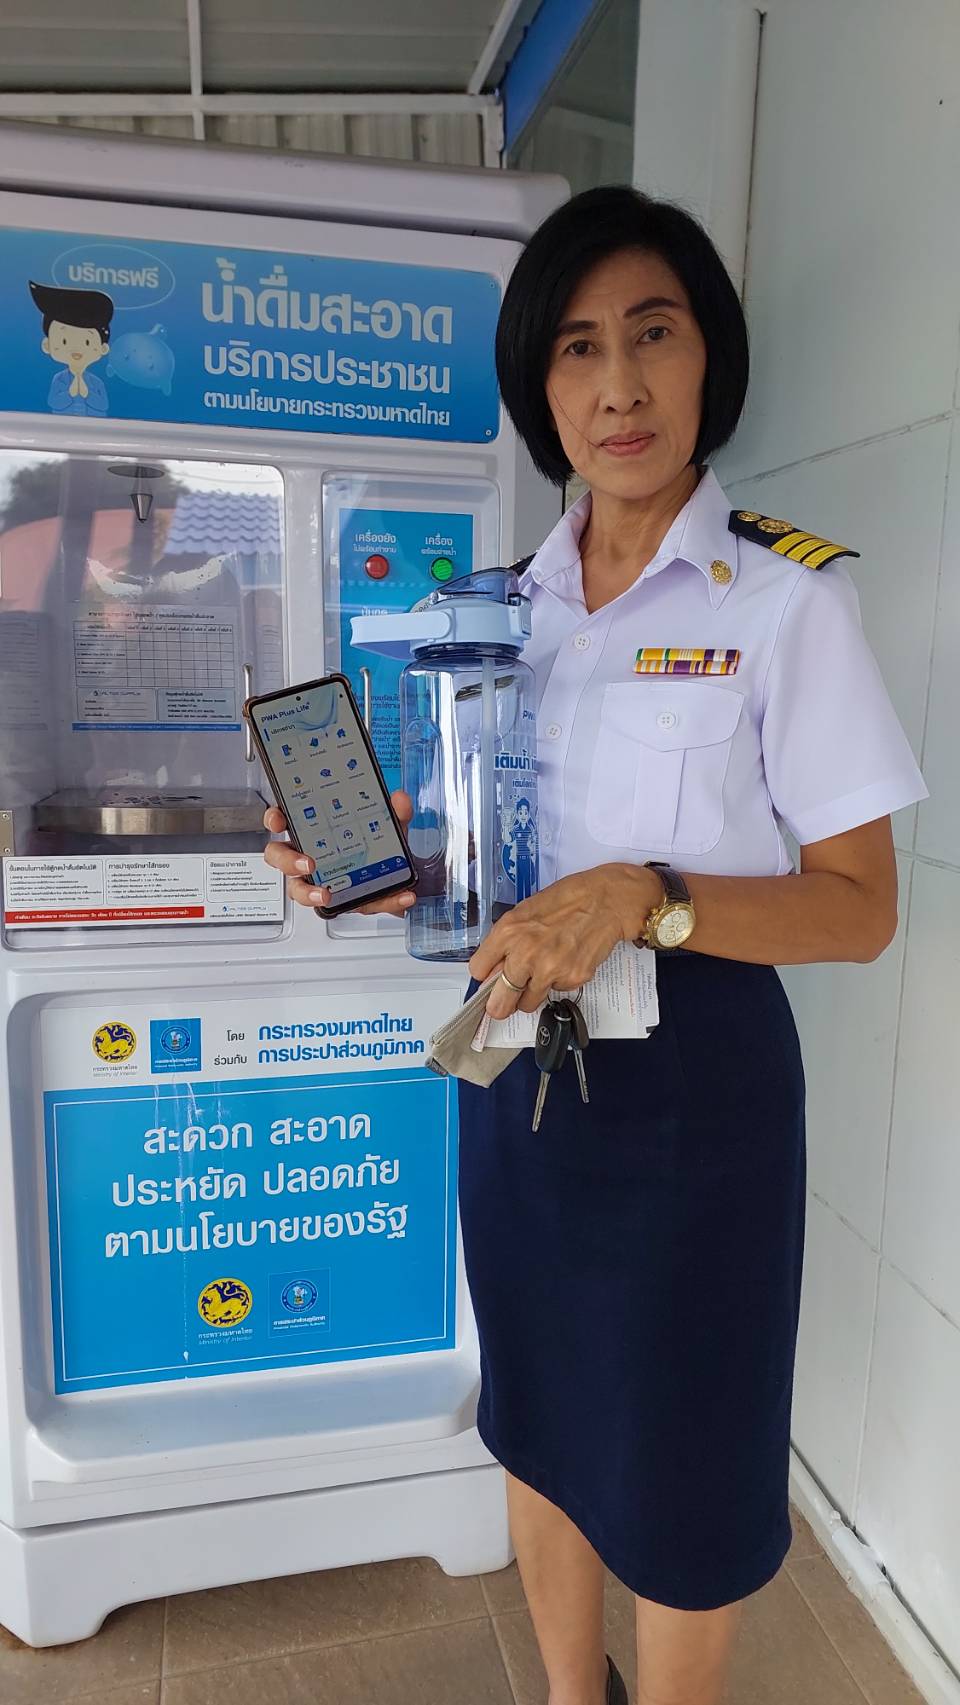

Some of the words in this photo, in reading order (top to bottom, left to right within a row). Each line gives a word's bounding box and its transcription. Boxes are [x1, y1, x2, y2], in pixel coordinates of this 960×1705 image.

[68, 262, 159, 290] บริการฟรี
[201, 257, 453, 345] น้ำดื่มสะอาด
[203, 340, 451, 394] บริการประชาชน
[203, 389, 450, 426] ตามนโยบายกระทรวงมหาดไทย
[355, 529, 397, 544] เครื่องยัง
[425, 533, 453, 545] เครื่อง
[261, 713, 279, 723] PWA
[279, 709, 295, 718] Plus
[495, 749, 530, 770] เติมน้ำ
[227, 1029, 245, 1042] โดย
[258, 1012, 413, 1041] กระทรวงมหาดไทย
[214, 1053, 248, 1067] ร่วมกับ
[258, 1037, 426, 1065] การประปาส่วนภูมิภาค
[143, 1121, 253, 1155] สะดวก
[269, 1112, 371, 1146] สะอาด
[111, 1166, 247, 1208] ประหยัด
[263, 1153, 400, 1197] ปลอดภัย
[104, 1200, 409, 1259] ตามนโยบายของรัฐ
